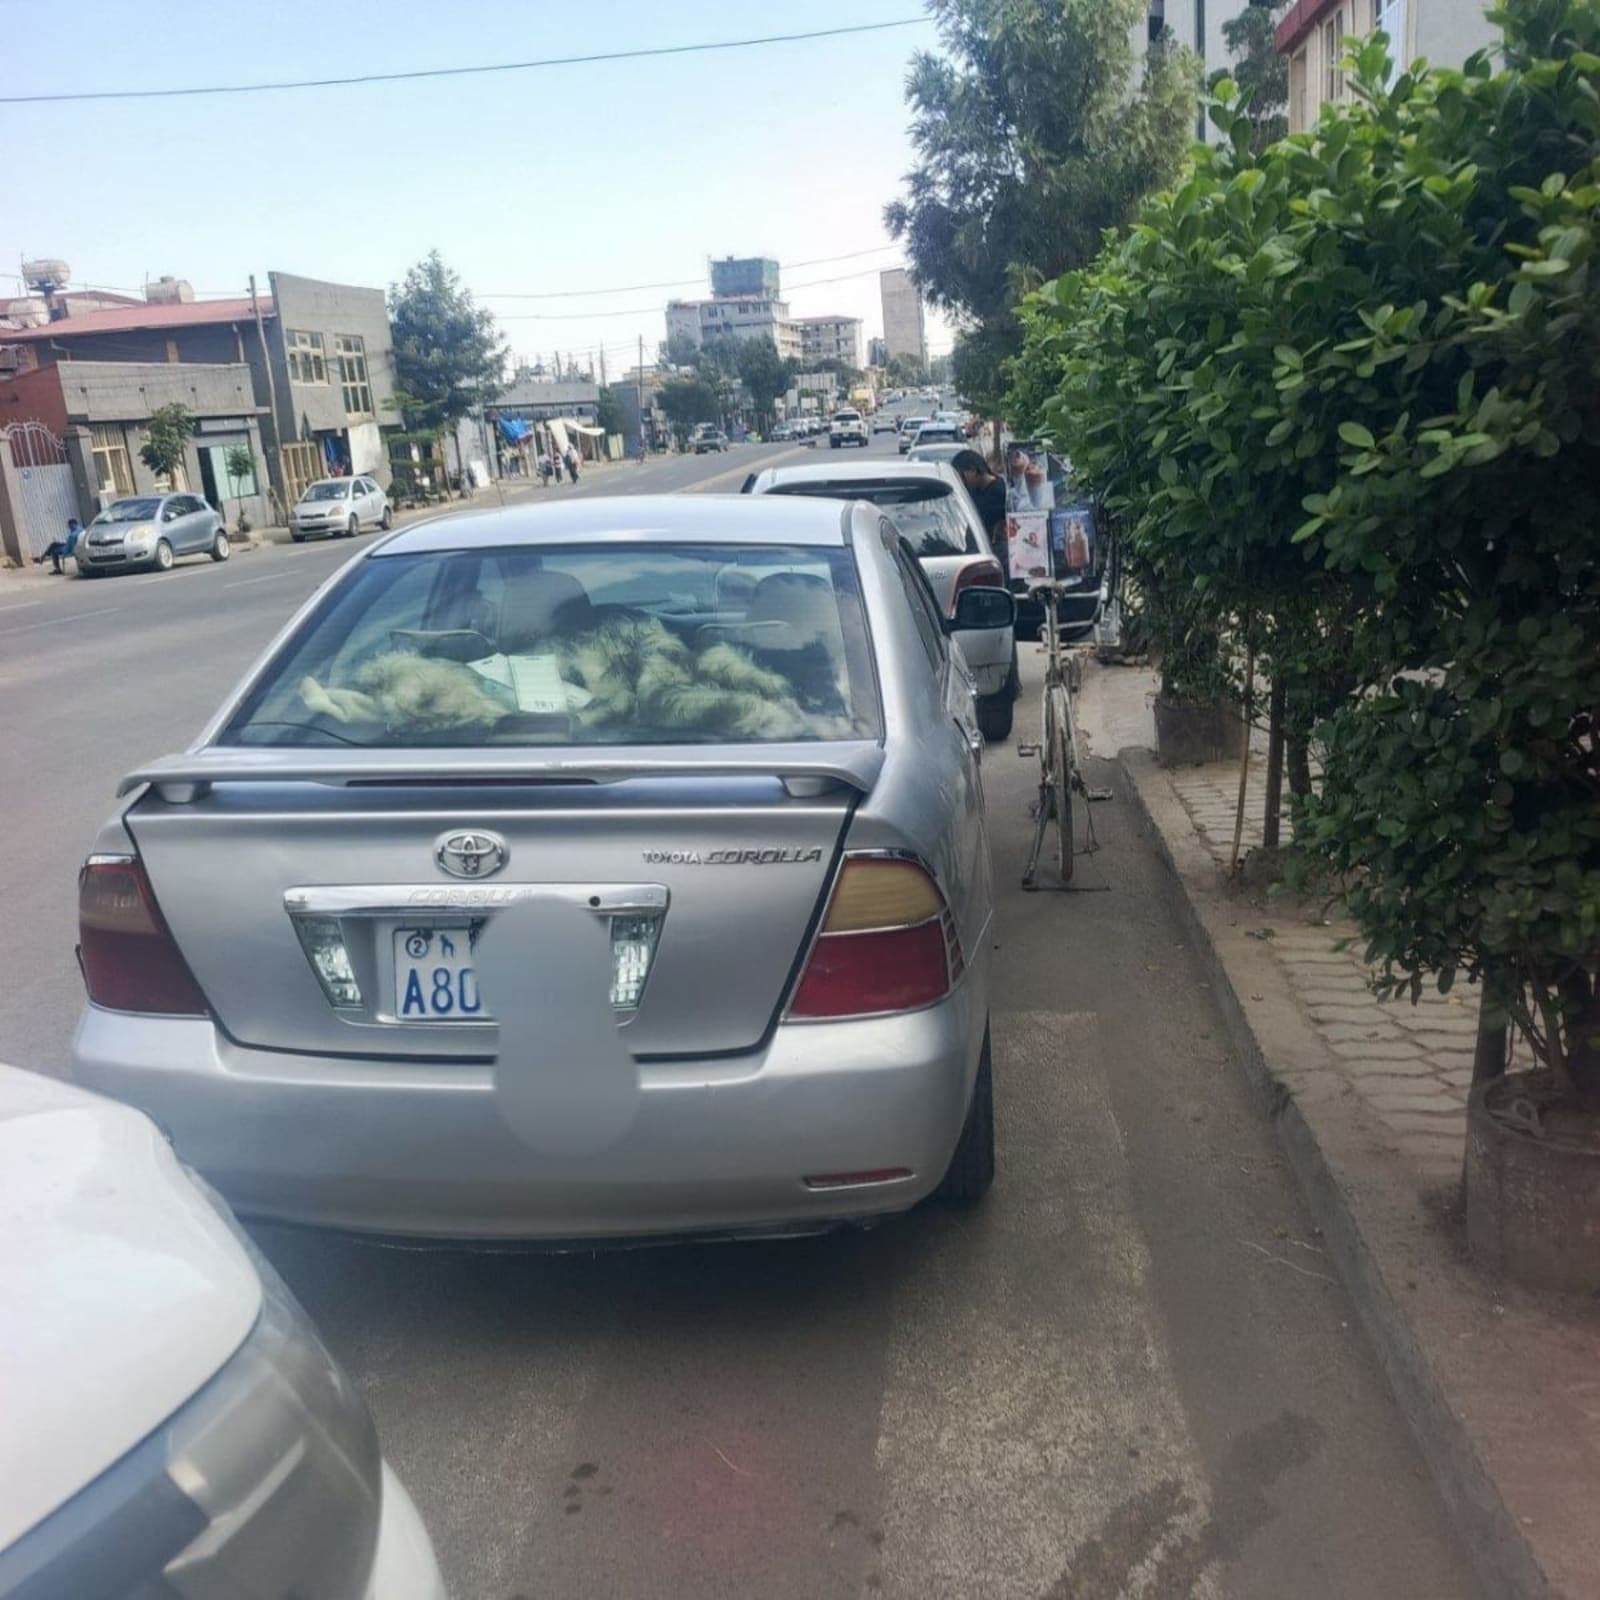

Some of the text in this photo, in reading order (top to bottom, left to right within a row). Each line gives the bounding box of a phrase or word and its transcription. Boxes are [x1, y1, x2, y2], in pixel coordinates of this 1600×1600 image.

[642, 847, 823, 865] TOYOTA COROLLA
[408, 888, 533, 906] COROLL
[402, 967, 482, 1015] A80
